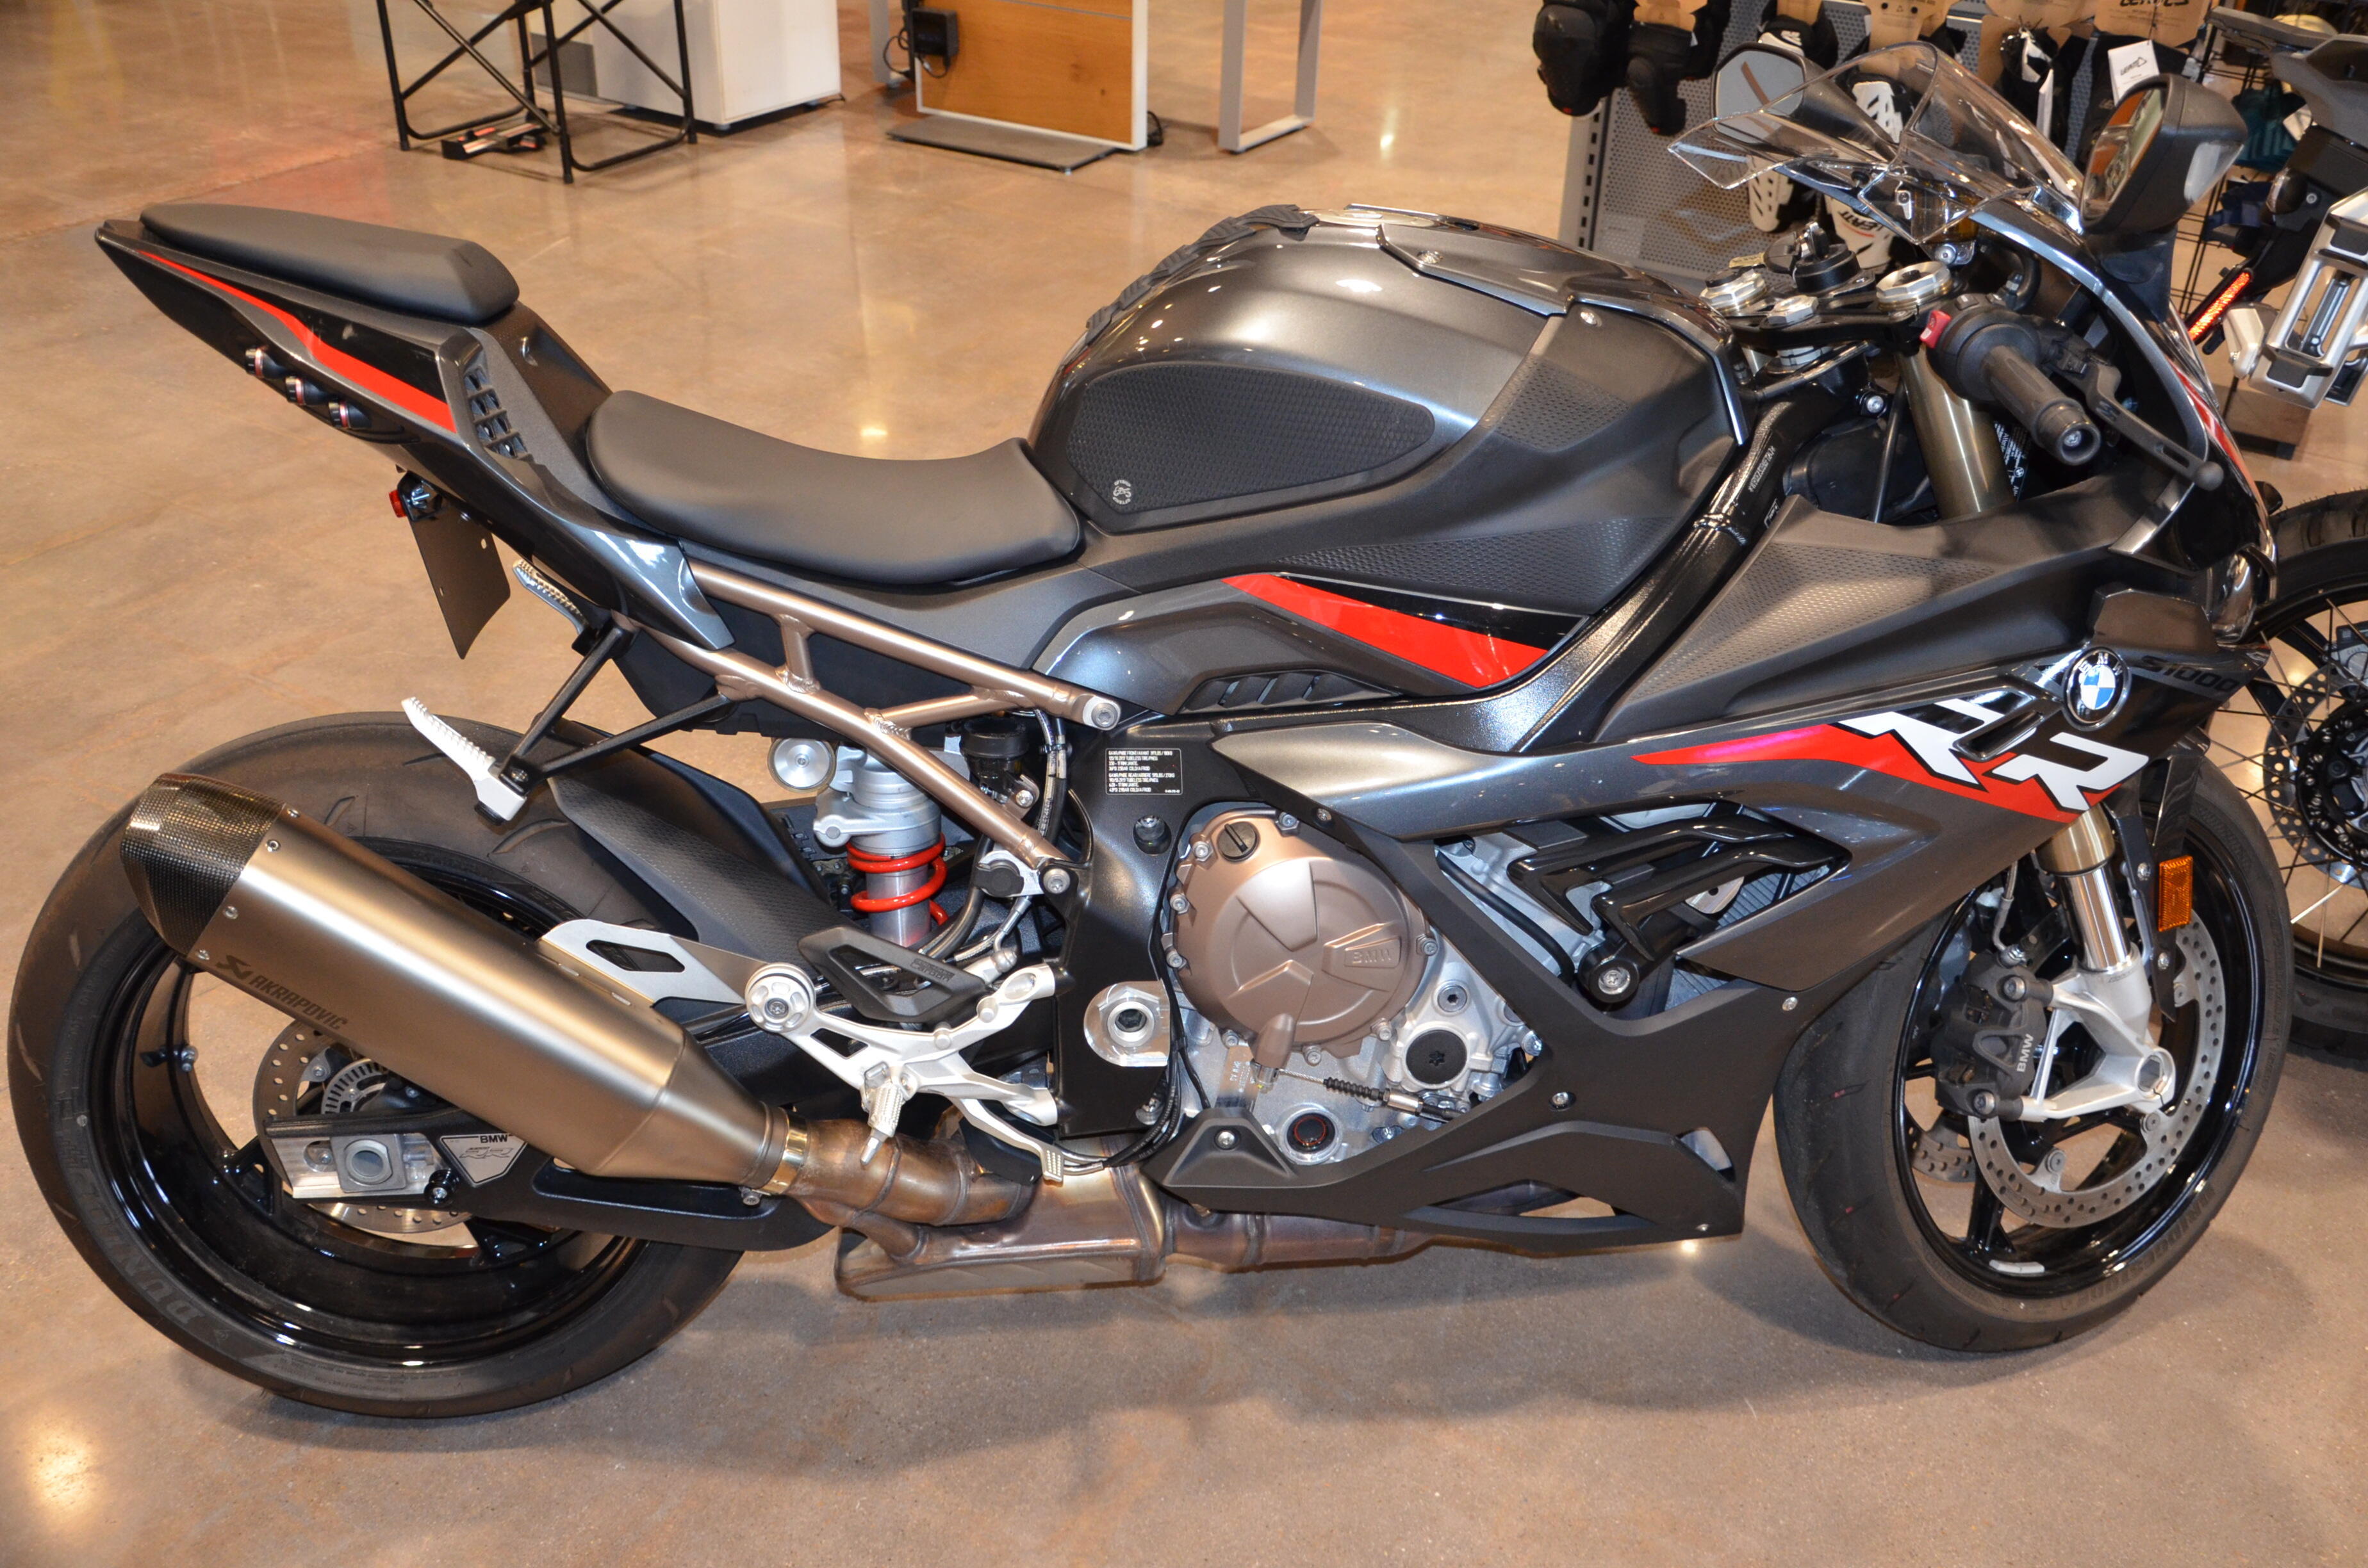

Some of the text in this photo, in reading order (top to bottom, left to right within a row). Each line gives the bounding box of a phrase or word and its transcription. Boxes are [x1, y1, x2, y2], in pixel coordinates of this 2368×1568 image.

[1353, 949, 1392, 963] BMW
[2016, 1033, 2034, 1073] BMW
[480, 1134, 508, 1143] BMW
